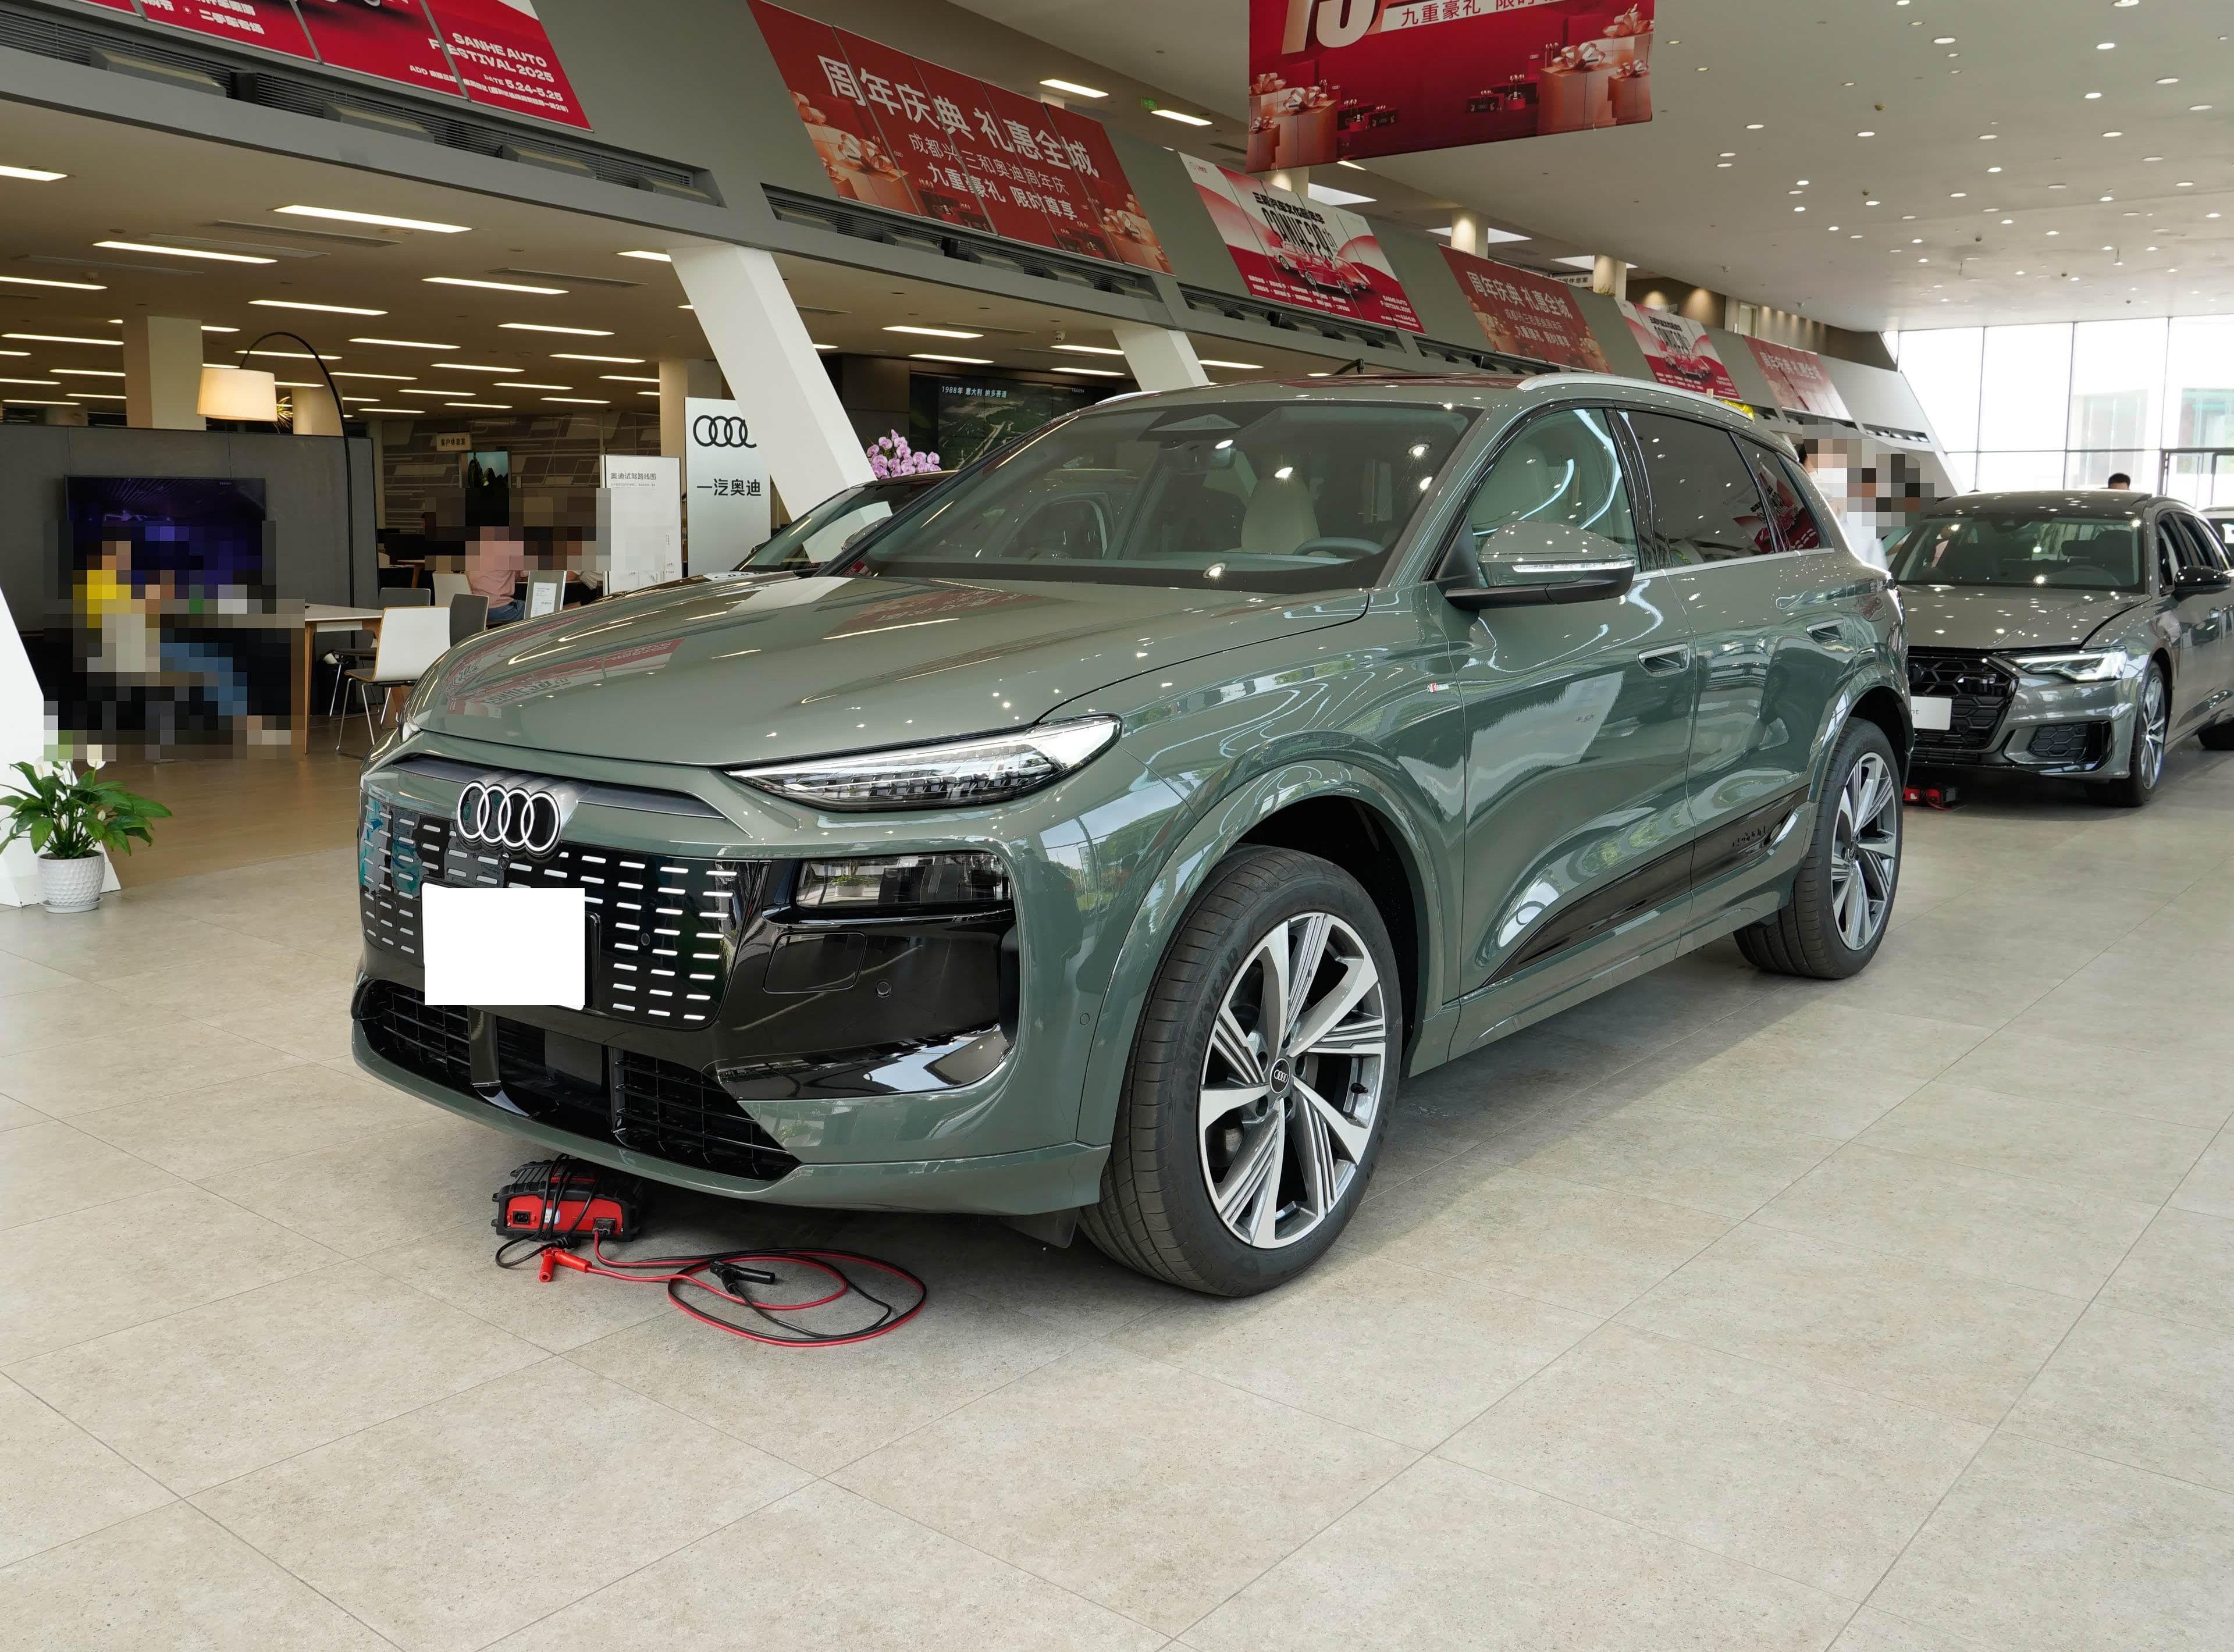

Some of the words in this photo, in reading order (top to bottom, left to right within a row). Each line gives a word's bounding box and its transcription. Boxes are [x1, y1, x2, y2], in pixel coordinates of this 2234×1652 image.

[1401, 0, 1481, 27] 九重豪礼
[428, 38, 517, 73] FESTIVAL
[515, 63, 555, 83] 2025
[451, 32, 507, 57] SANHE
[506, 48, 547, 68] AUTO
[409, 65, 429, 76] ADD
[504, 79, 564, 102] 5.24-5.25
[817, 55, 975, 141] 周年庆典
[974, 107, 1099, 178] 礼惠全城
[908, 133, 1070, 195] 成都兴三和奥迪周年庆
[927, 162, 1006, 203] 九重豪礼
[1009, 186, 1077, 220] 限时尊享
[1466, 270, 1525, 308] 周年庆典
[1520, 286, 1573, 319] 礼惠全城
[942, 386, 963, 394] 1988年
[696, 478, 762, 496] 一汽奥迪
